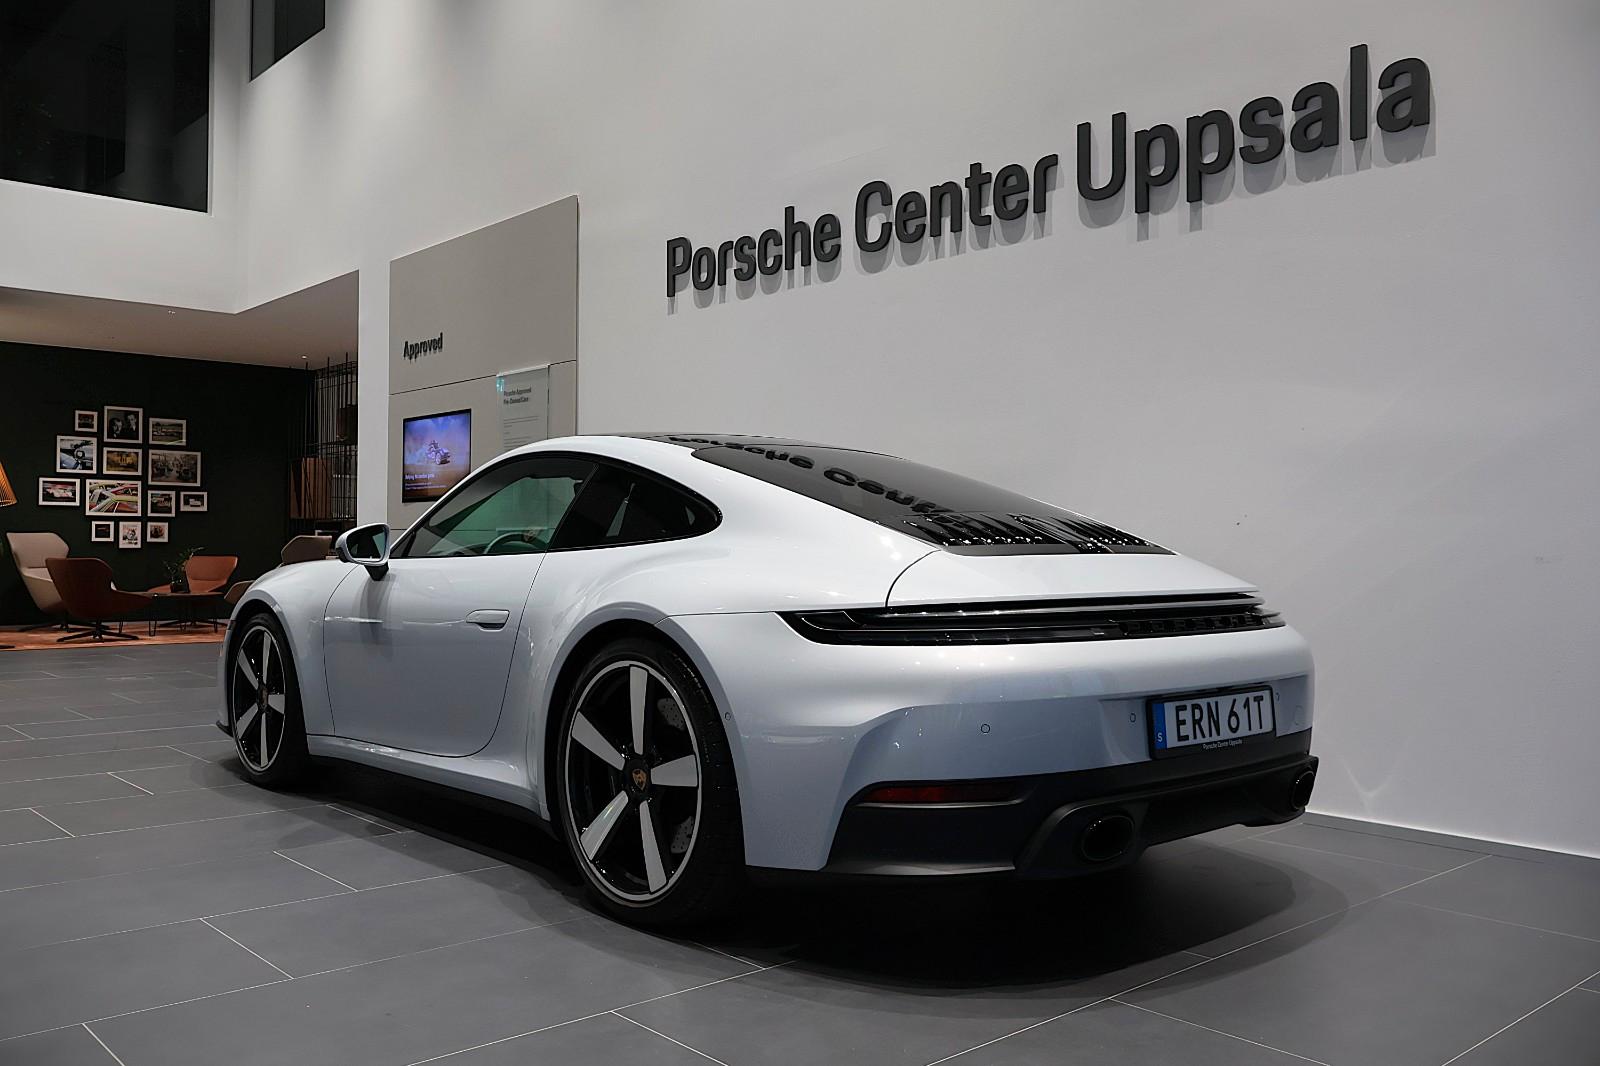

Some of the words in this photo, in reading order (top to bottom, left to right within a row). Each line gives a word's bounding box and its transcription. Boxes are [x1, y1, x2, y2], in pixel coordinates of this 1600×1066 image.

[667, 206, 842, 298] Porsche
[855, 154, 1059, 253] Center
[1076, 43, 1431, 214] Uppsala
[404, 332, 443, 361] Approved
[1157, 732, 1163, 742] S
[1175, 701, 1221, 742] ERN
[1227, 695, 1264, 734] 61T
